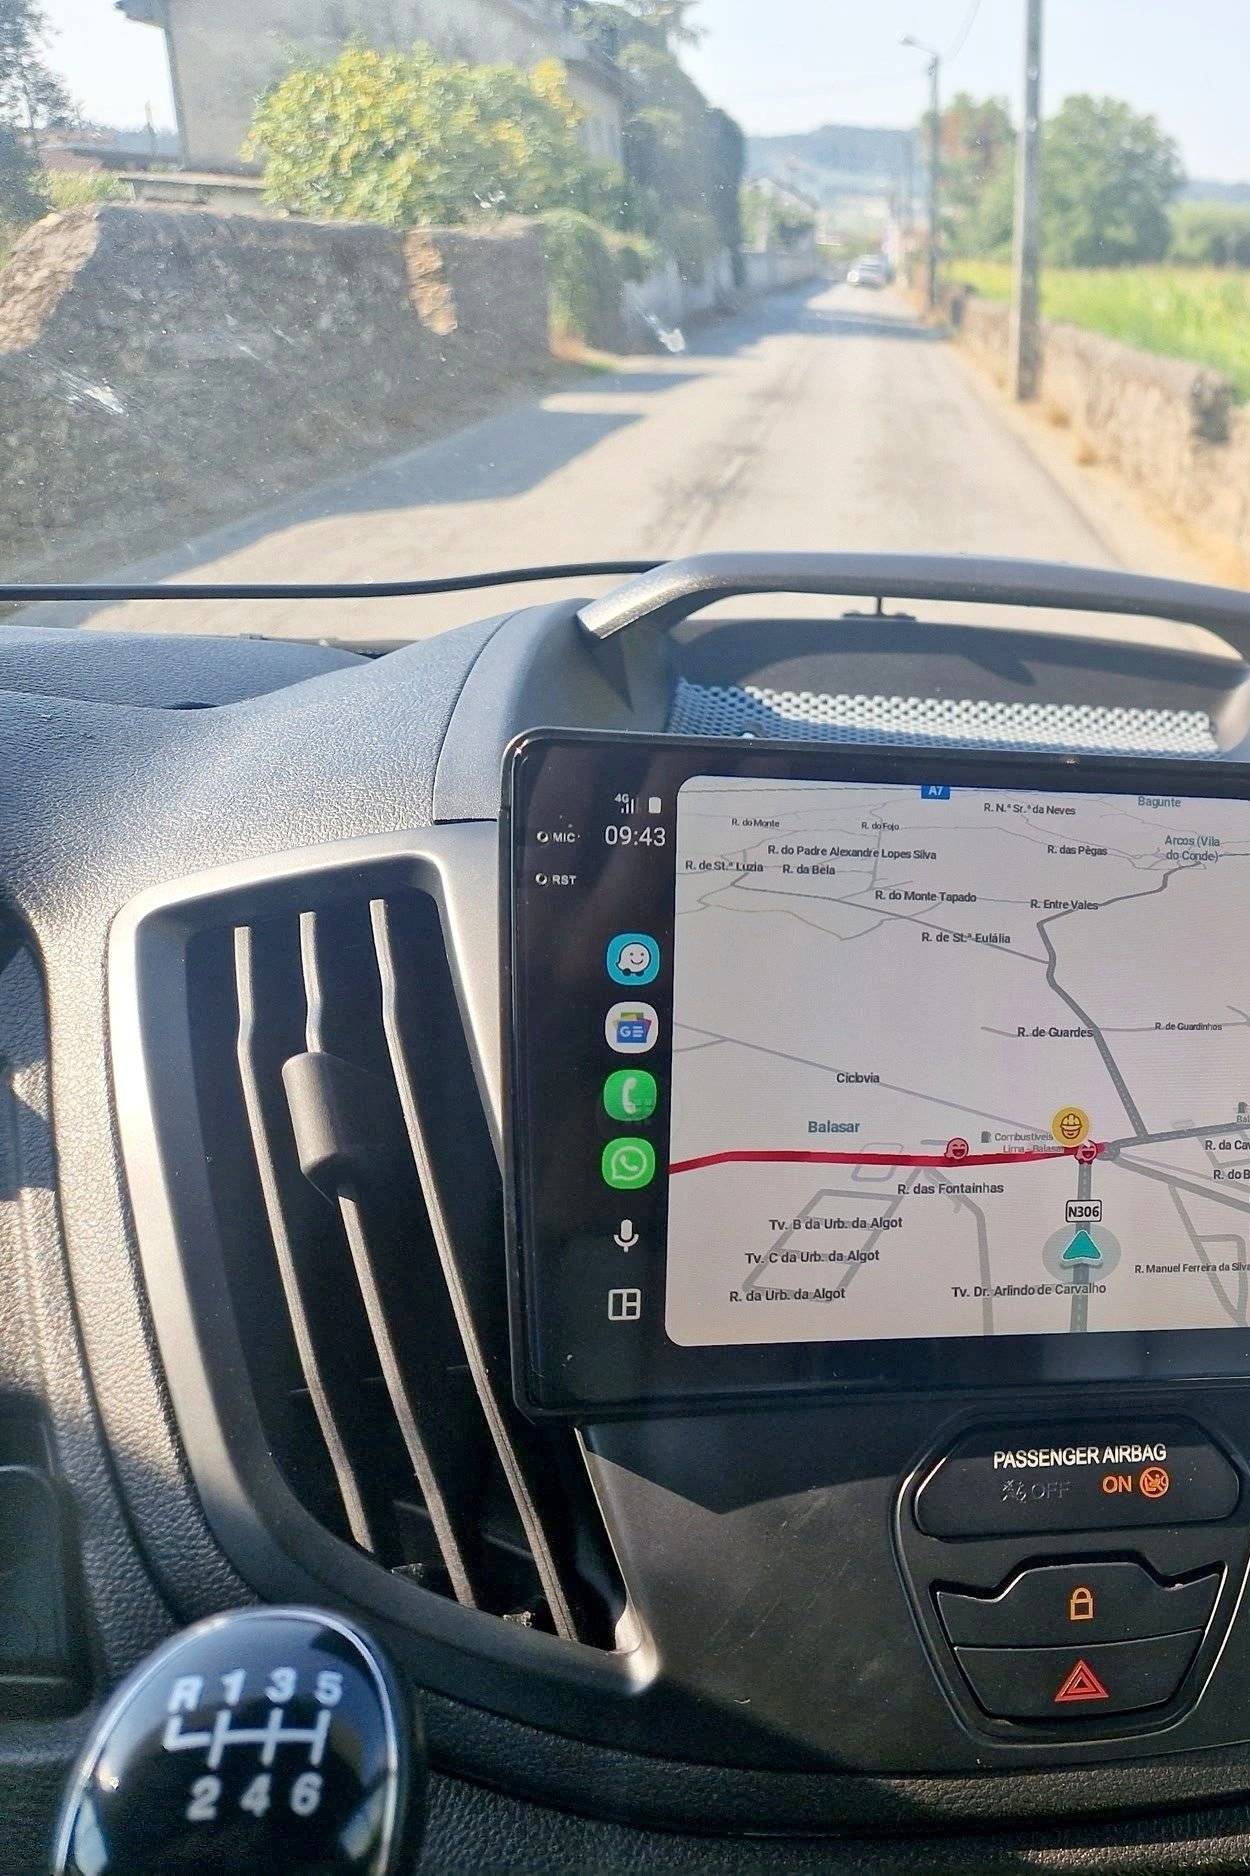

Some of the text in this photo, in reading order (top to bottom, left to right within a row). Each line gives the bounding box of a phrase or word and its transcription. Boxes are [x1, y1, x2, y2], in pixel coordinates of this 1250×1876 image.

[927, 785, 943, 796] A7
[614, 793, 630, 803] 4G
[1138, 797, 1181, 808] Bagunte
[984, 803, 1076, 815] R. da Neves
[872, 822, 881, 830] do
[552, 832, 576, 842] MIC
[605, 825, 666, 846] 09:43
[1165, 835, 1220, 848] Arcos (Vila
[768, 845, 936, 860] R. do Padre Alexandre Lopes Silva
[1048, 845, 1076, 854] R. das
[1166, 850, 1219, 863] do Conde)
[685, 860, 696, 870] R.
[699, 861, 712, 870] de
[736, 862, 763, 872] Luzia
[782, 864, 836, 875] R. da Bela
[552, 875, 576, 885] RST
[875, 890, 976, 905] R. do Monte Tapado
[1030, 900, 1098, 910] R. Entre Vales
[921, 932, 1011, 943] R. de Eulália
[1166, 1022, 1175, 1030] de
[1017, 1027, 1094, 1037] R. de Guardes
[836, 1072, 880, 1084] Ciclovia
[808, 1121, 860, 1133] Balasar
[1205, 1140, 1216, 1150] R.
[1219, 1140, 1231, 1150] da
[1213, 1170, 1224, 1179] R.
[1228, 1170, 1241, 1179] do
[898, 1183, 1004, 1194] R. das Fontainhas
[1068, 1206, 1099, 1217] N306
[769, 1218, 902, 1232] Tv. B da Urb. da Algot
[745, 1250, 880, 1264] Tv. C da Urb. da Algot
[1135, 1265, 1144, 1273] R.
[1146, 1264, 1180, 1273] Manuel
[1183, 1263, 1216, 1272] Ferreira
[1219, 1263, 1230, 1271] da
[730, 1288, 846, 1302] R. da Urb. da Algot
[952, 1283, 1106, 1297] Tv. Dr. Arlindo de Carvalho
[994, 1443, 1167, 1469] PASSENGER AIRBAG
[1103, 1475, 1132, 1494] ON
[221, 1668, 247, 1706] 1
[264, 1666, 297, 1703] 3
[315, 1670, 343, 1706] 5
[186, 1771, 323, 1822] 2 4 6
